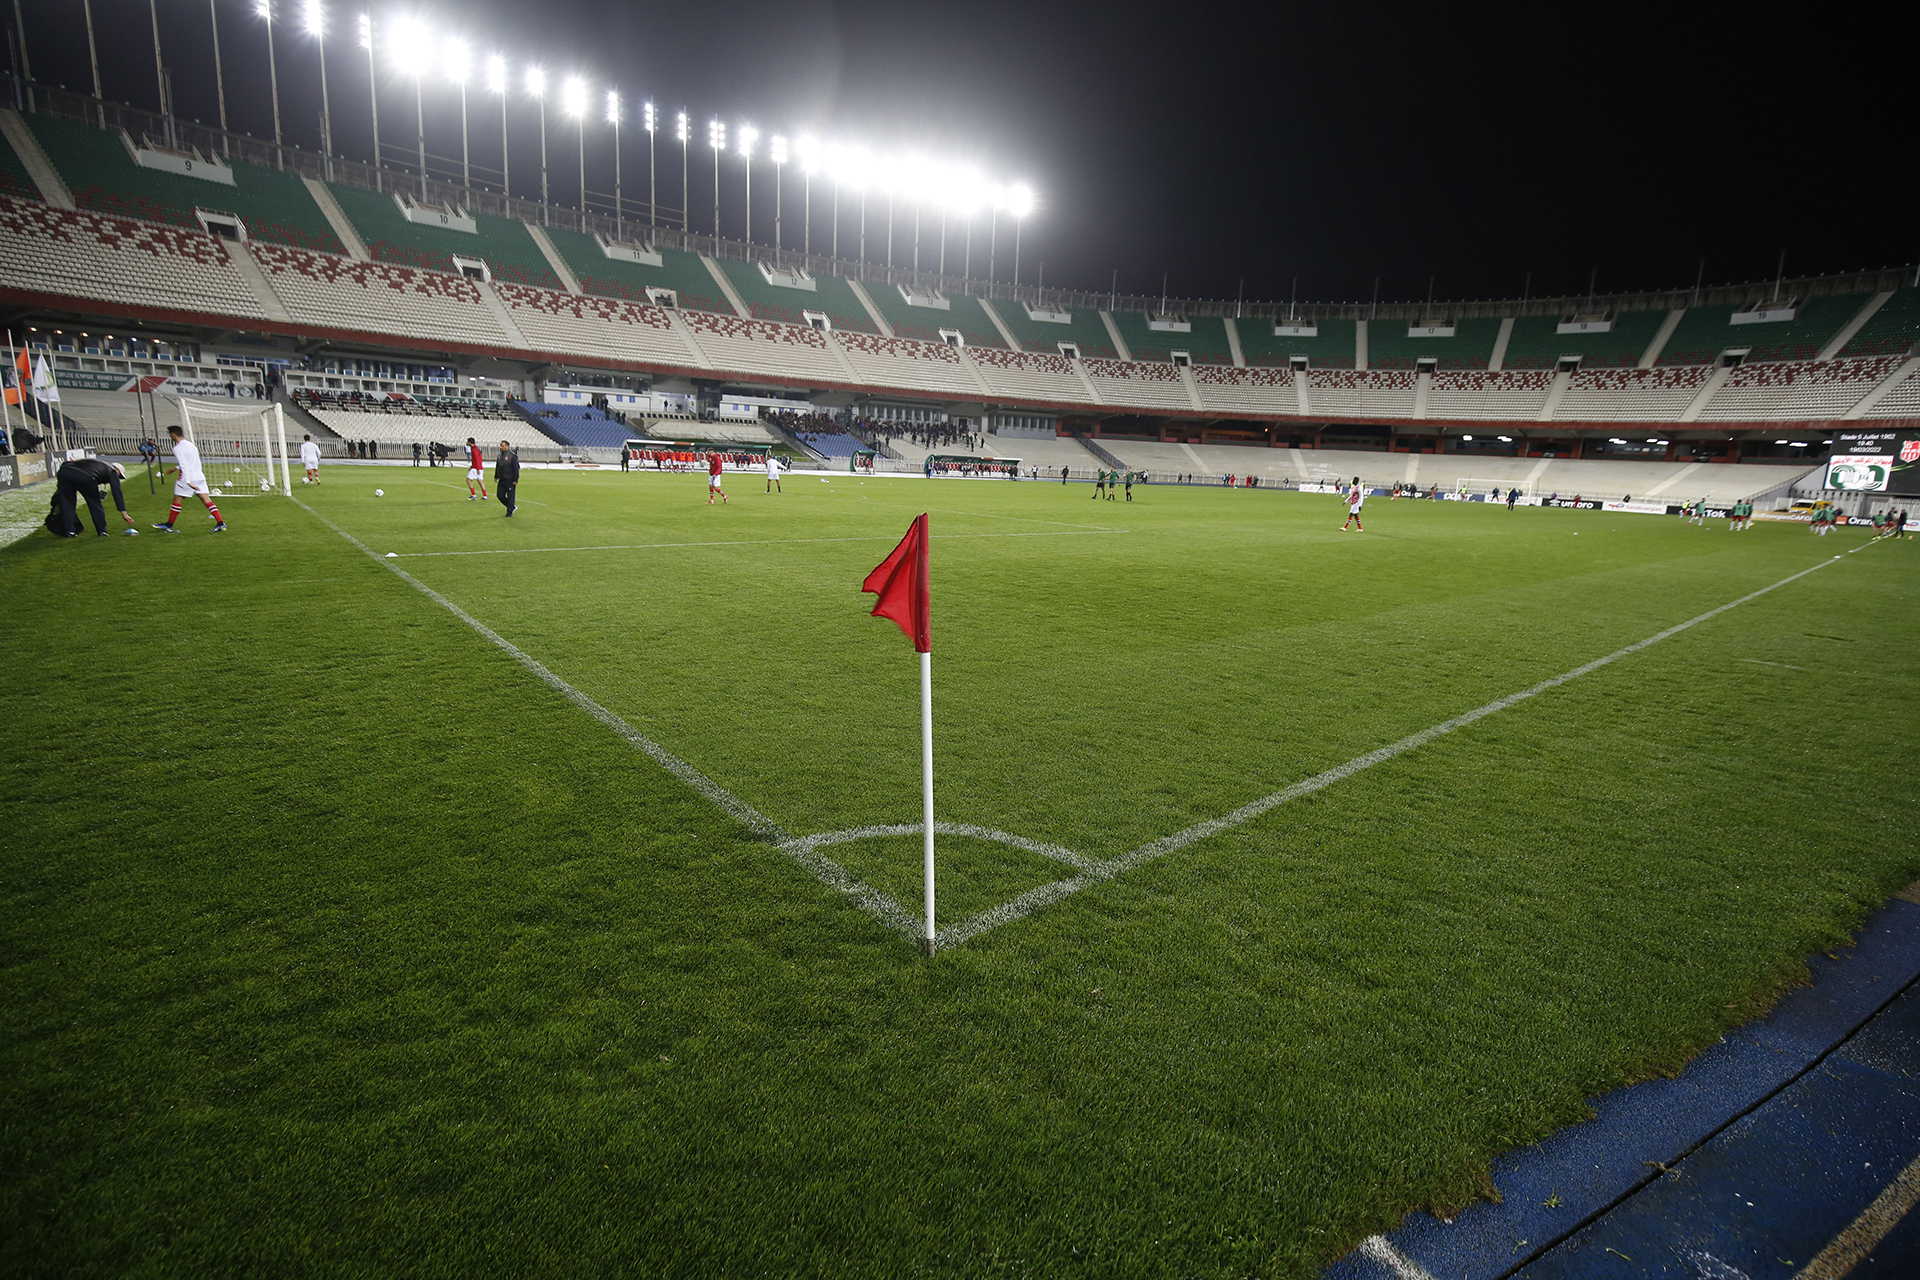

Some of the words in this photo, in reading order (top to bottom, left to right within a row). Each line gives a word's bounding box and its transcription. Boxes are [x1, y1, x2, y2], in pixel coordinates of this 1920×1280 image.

[185, 160, 192, 171] 9
[440, 214, 448, 224] 10
[633, 251, 640, 260] 11
[791, 277, 798, 286] 12
[1428, 327, 1435, 335] 17
[1625, 504, 1662, 512] TotalEnergies
